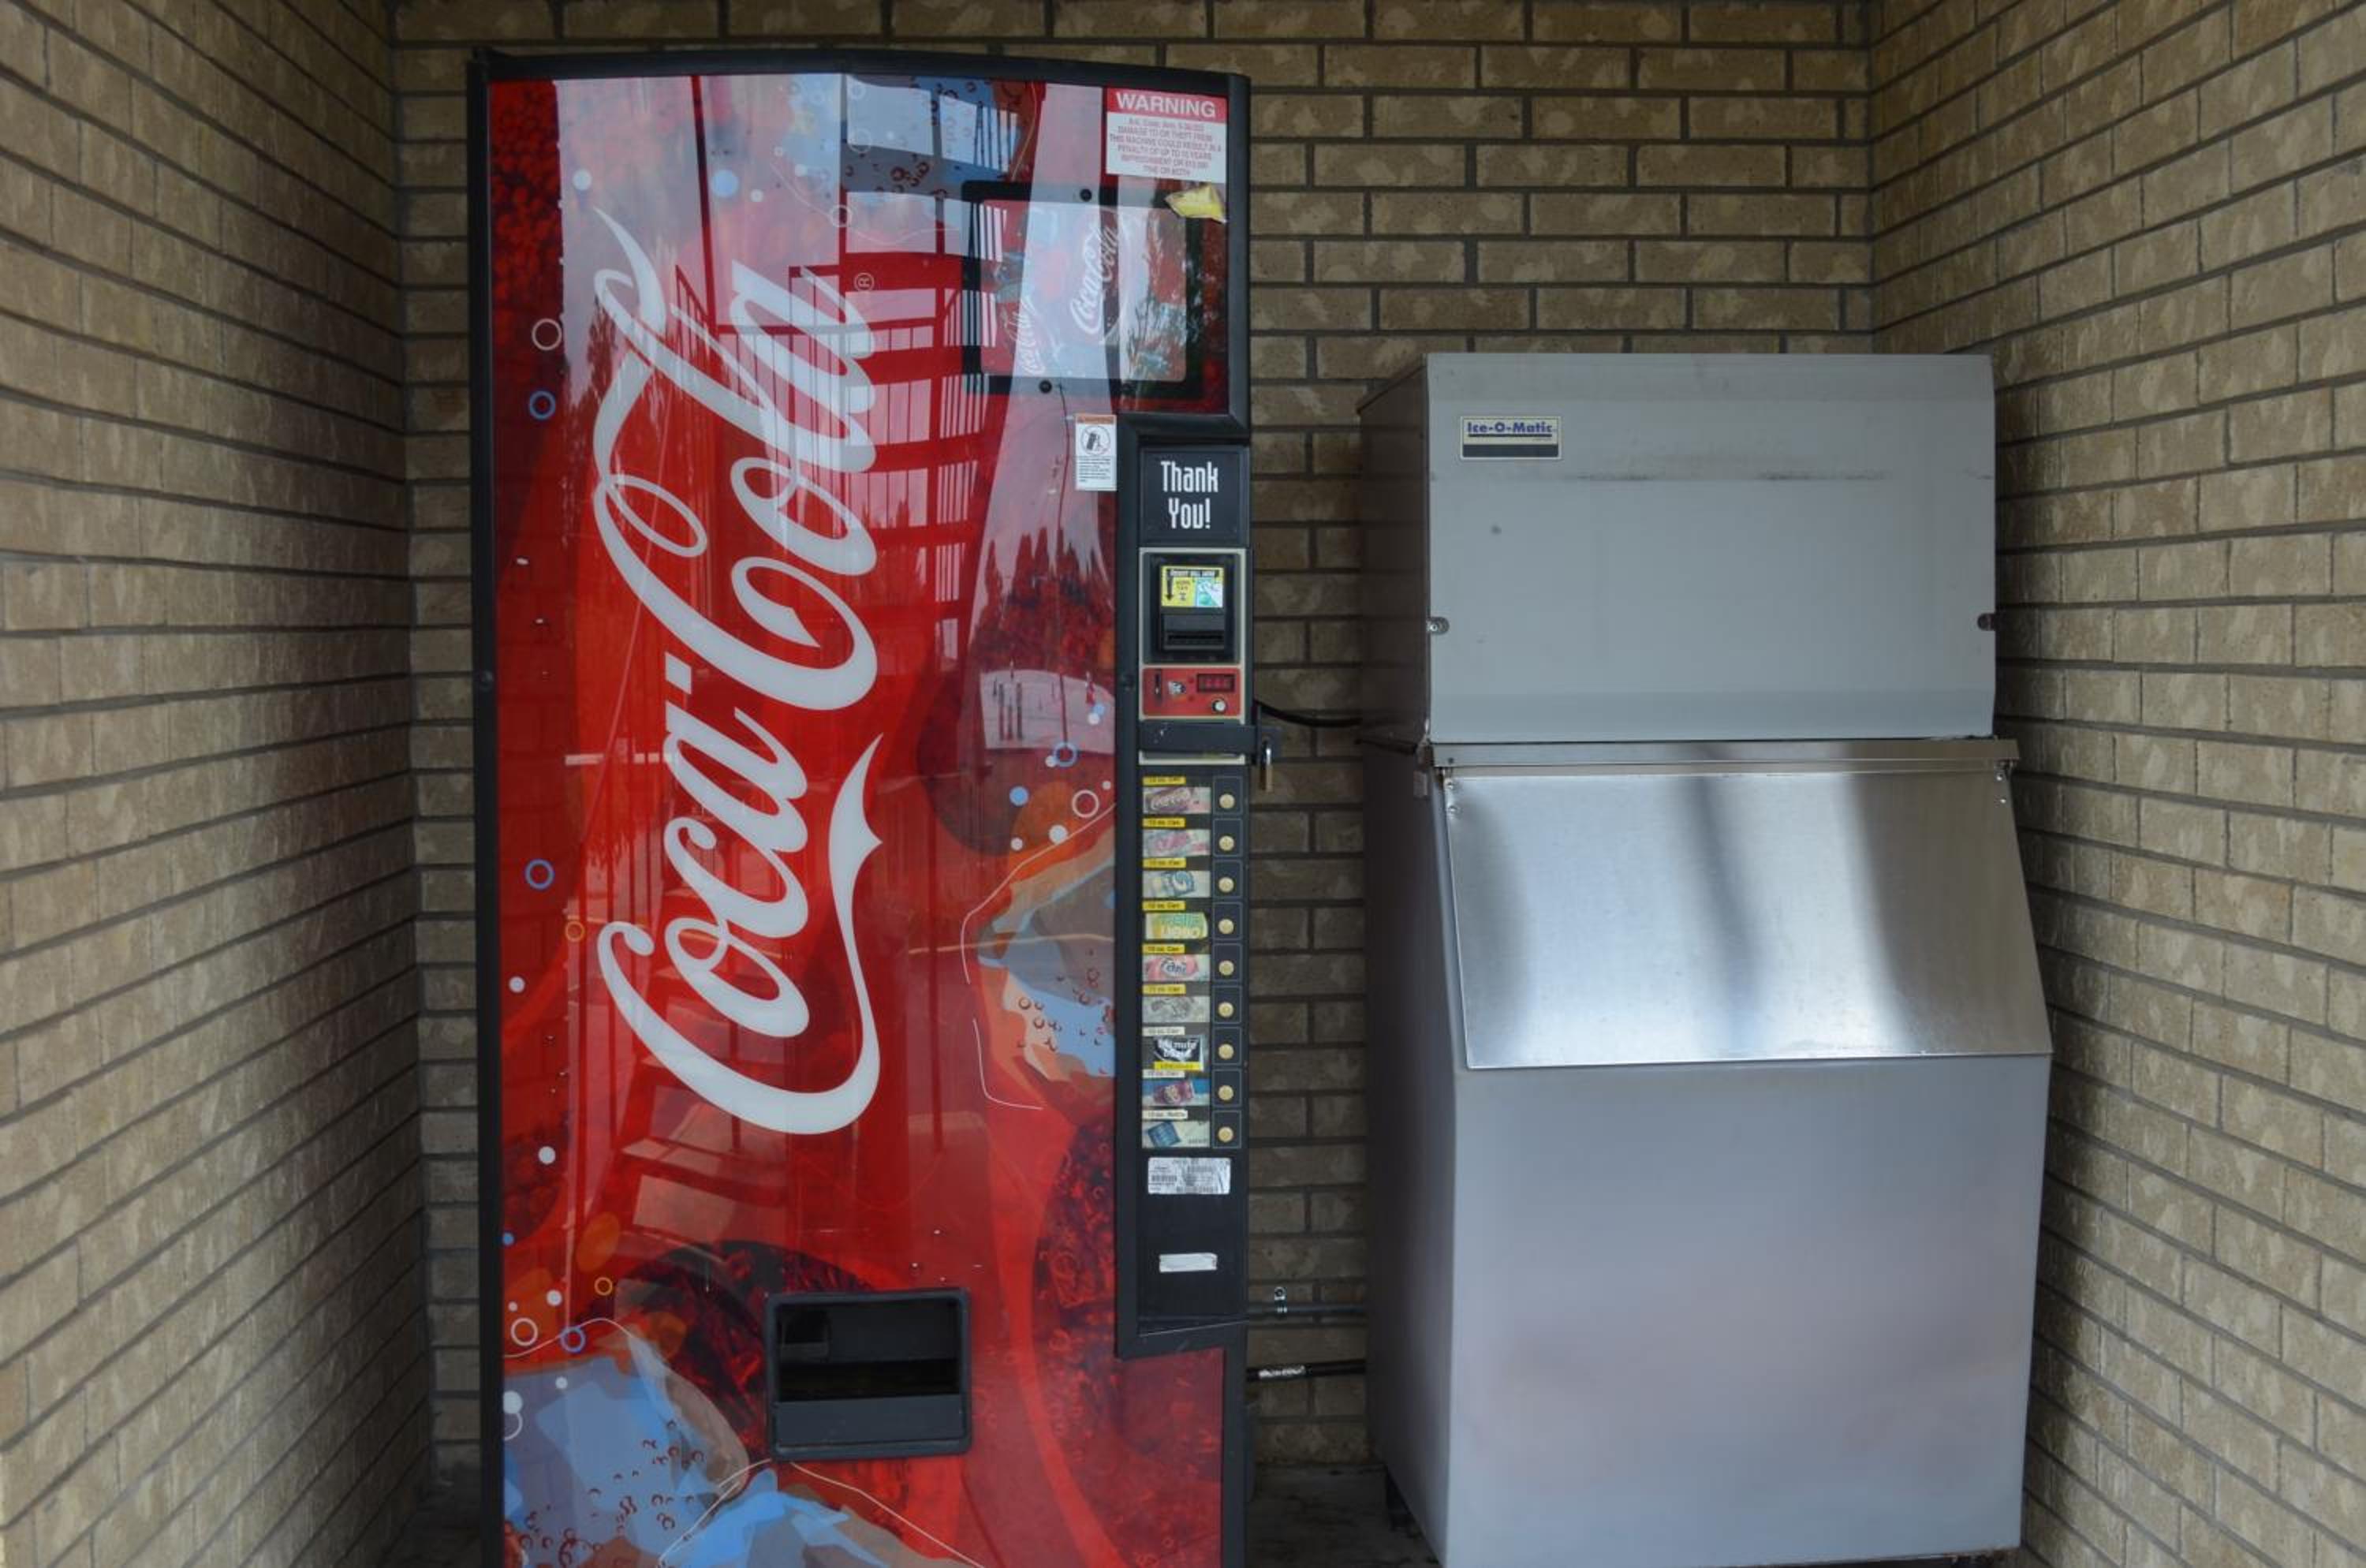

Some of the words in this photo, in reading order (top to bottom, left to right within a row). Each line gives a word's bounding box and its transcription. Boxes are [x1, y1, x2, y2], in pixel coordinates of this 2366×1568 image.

[1116, 91, 1215, 118] WARNING
[1468, 421, 1553, 433] Ice-O-Matic
[1160, 461, 1218, 493] Thank
[1168, 498, 1211, 529] You!
[592, 207, 883, 1134] Coca-Cola
